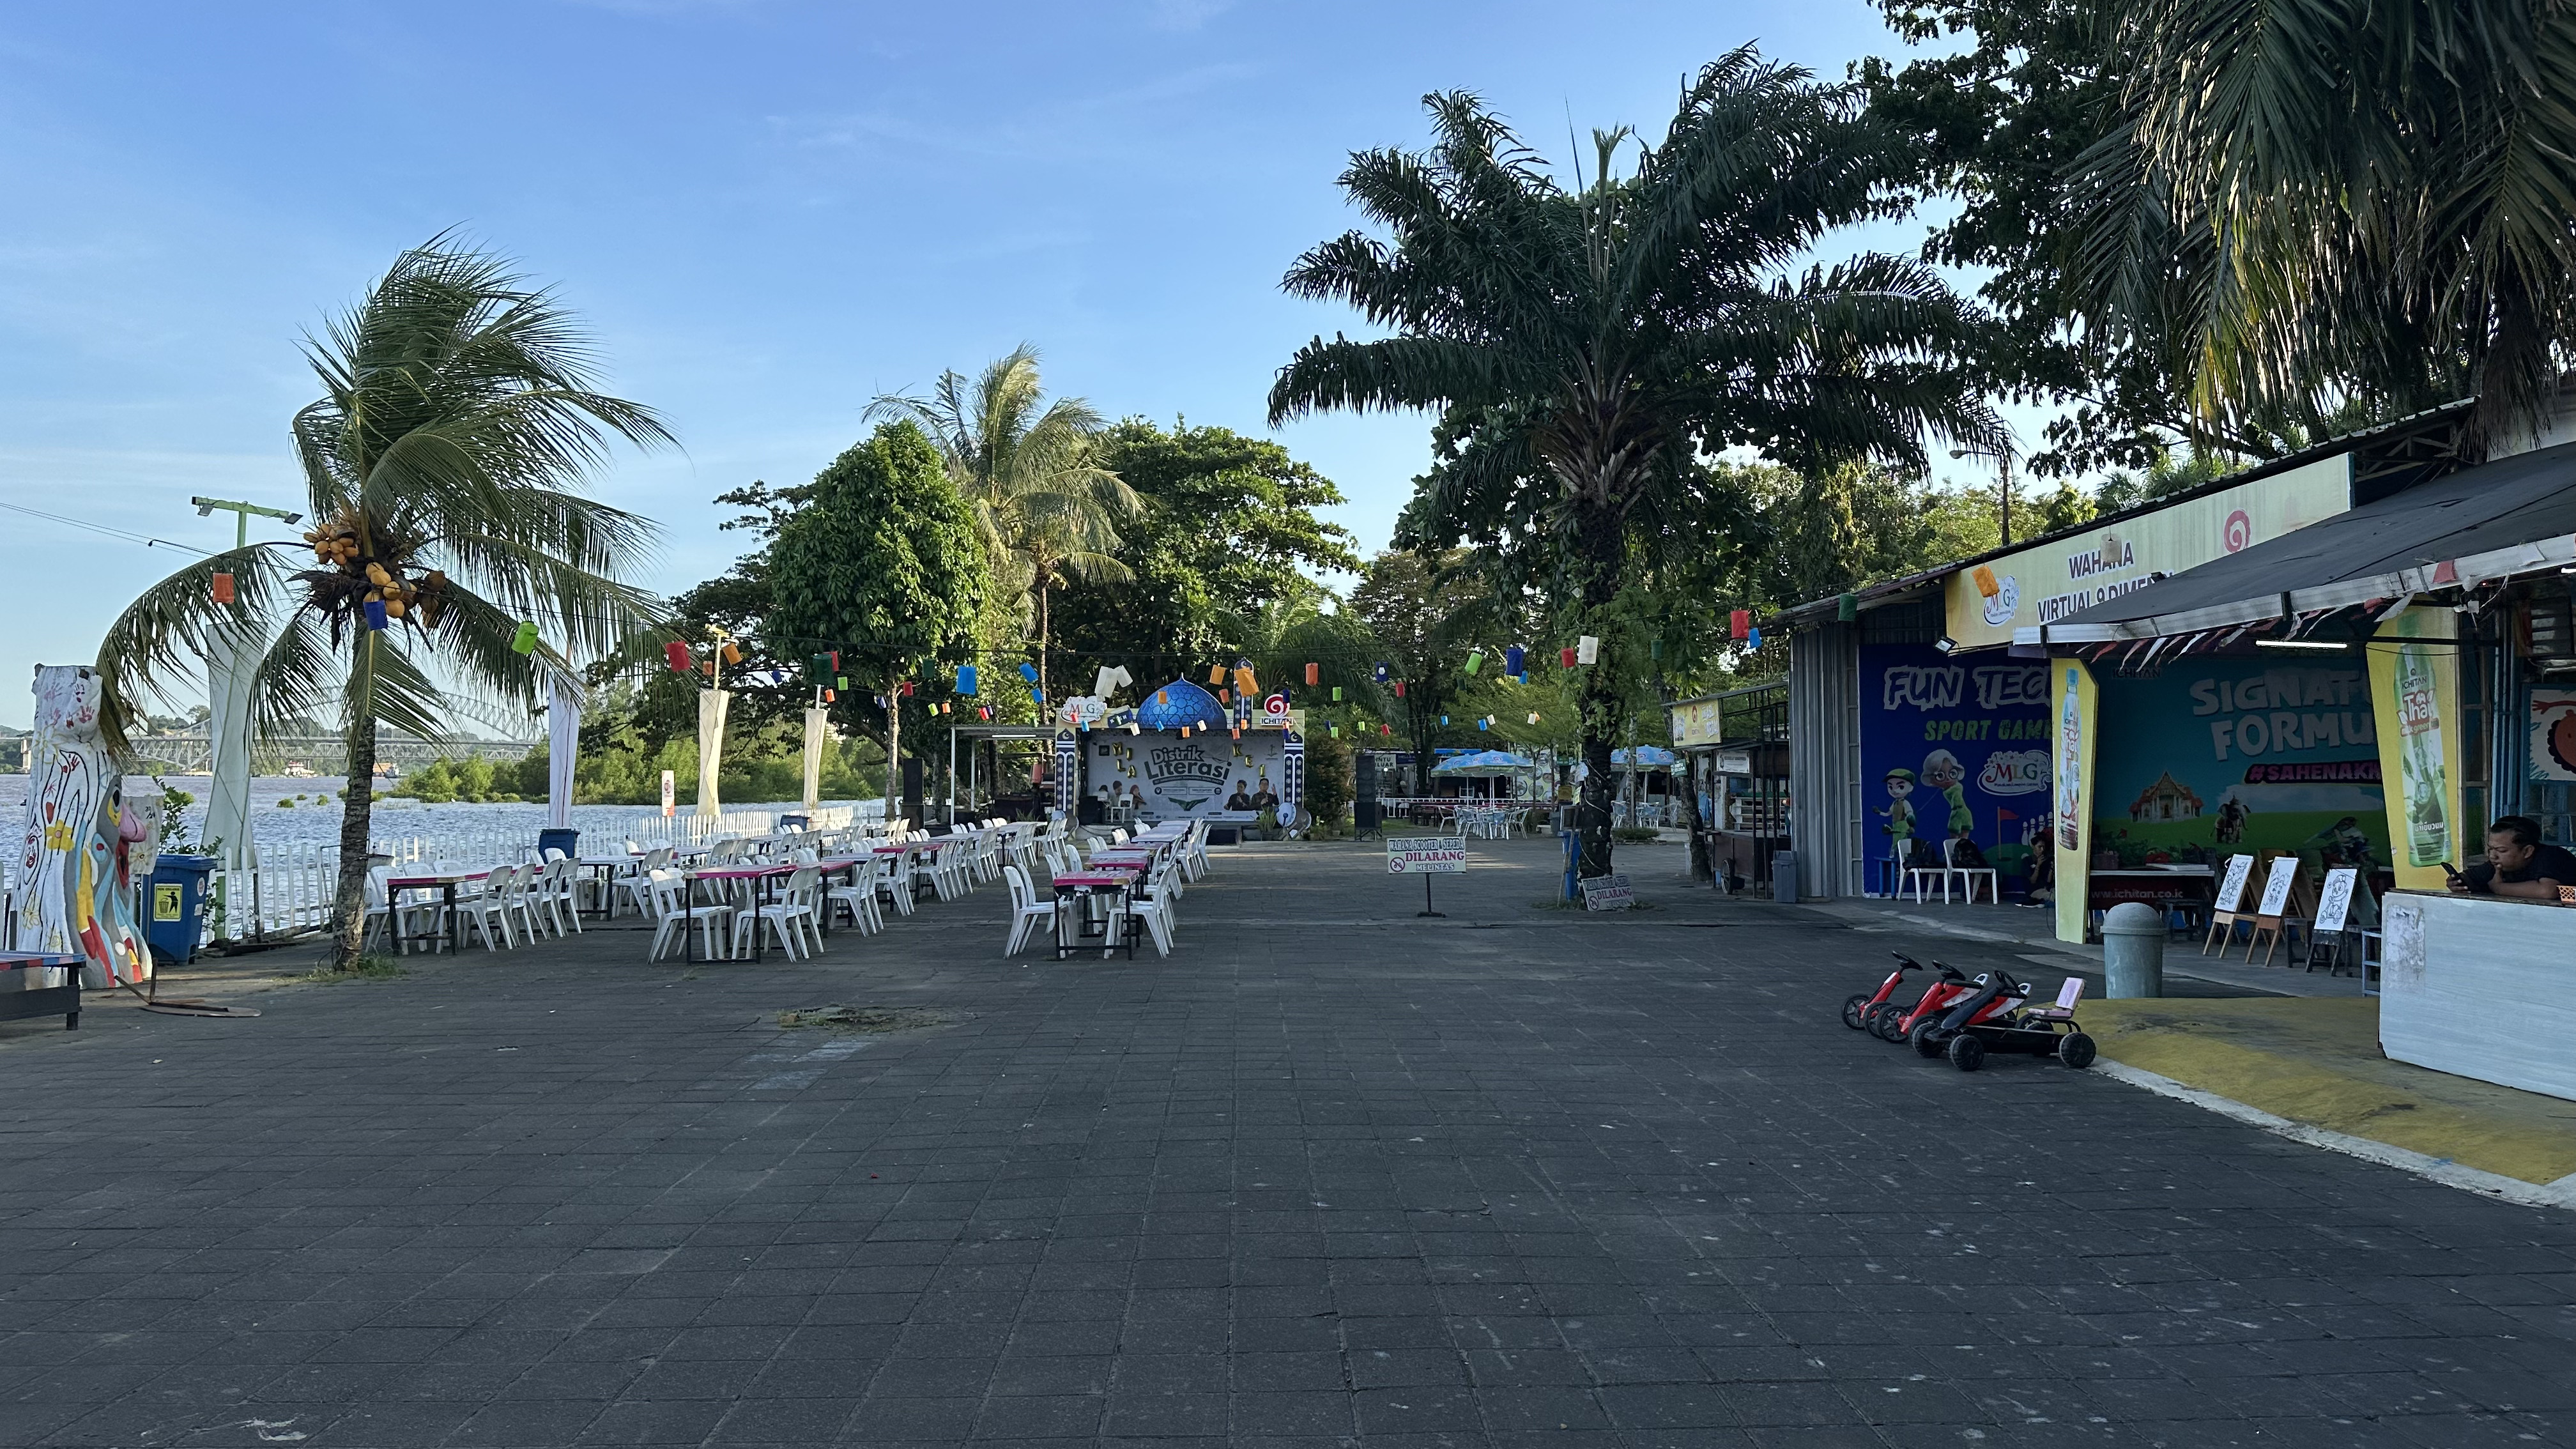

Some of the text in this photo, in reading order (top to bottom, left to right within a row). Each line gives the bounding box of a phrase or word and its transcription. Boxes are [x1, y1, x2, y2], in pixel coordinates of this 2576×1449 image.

[2112, 667, 2161, 678] ICHITAN
[1887, 668, 1963, 707] FUN
[2402, 676, 2427, 689] ICHITAN
[1924, 719, 1992, 741] SPORT
[2210, 712, 2375, 762] FORMU
[1151, 746, 1204, 765] Distrik
[1144, 761, 1232, 780] Literasi
[1985, 763, 2037, 783] MLG
[1389, 839, 1413, 851] WAHANA
[1414, 839, 1439, 851] SCOOTER
[1443, 838, 1465, 850] SEPEDA
[1405, 851, 1465, 861] DILARANG
[1416, 862, 1455, 871] MELINTAS
[1597, 887, 1632, 900] DILARANG
